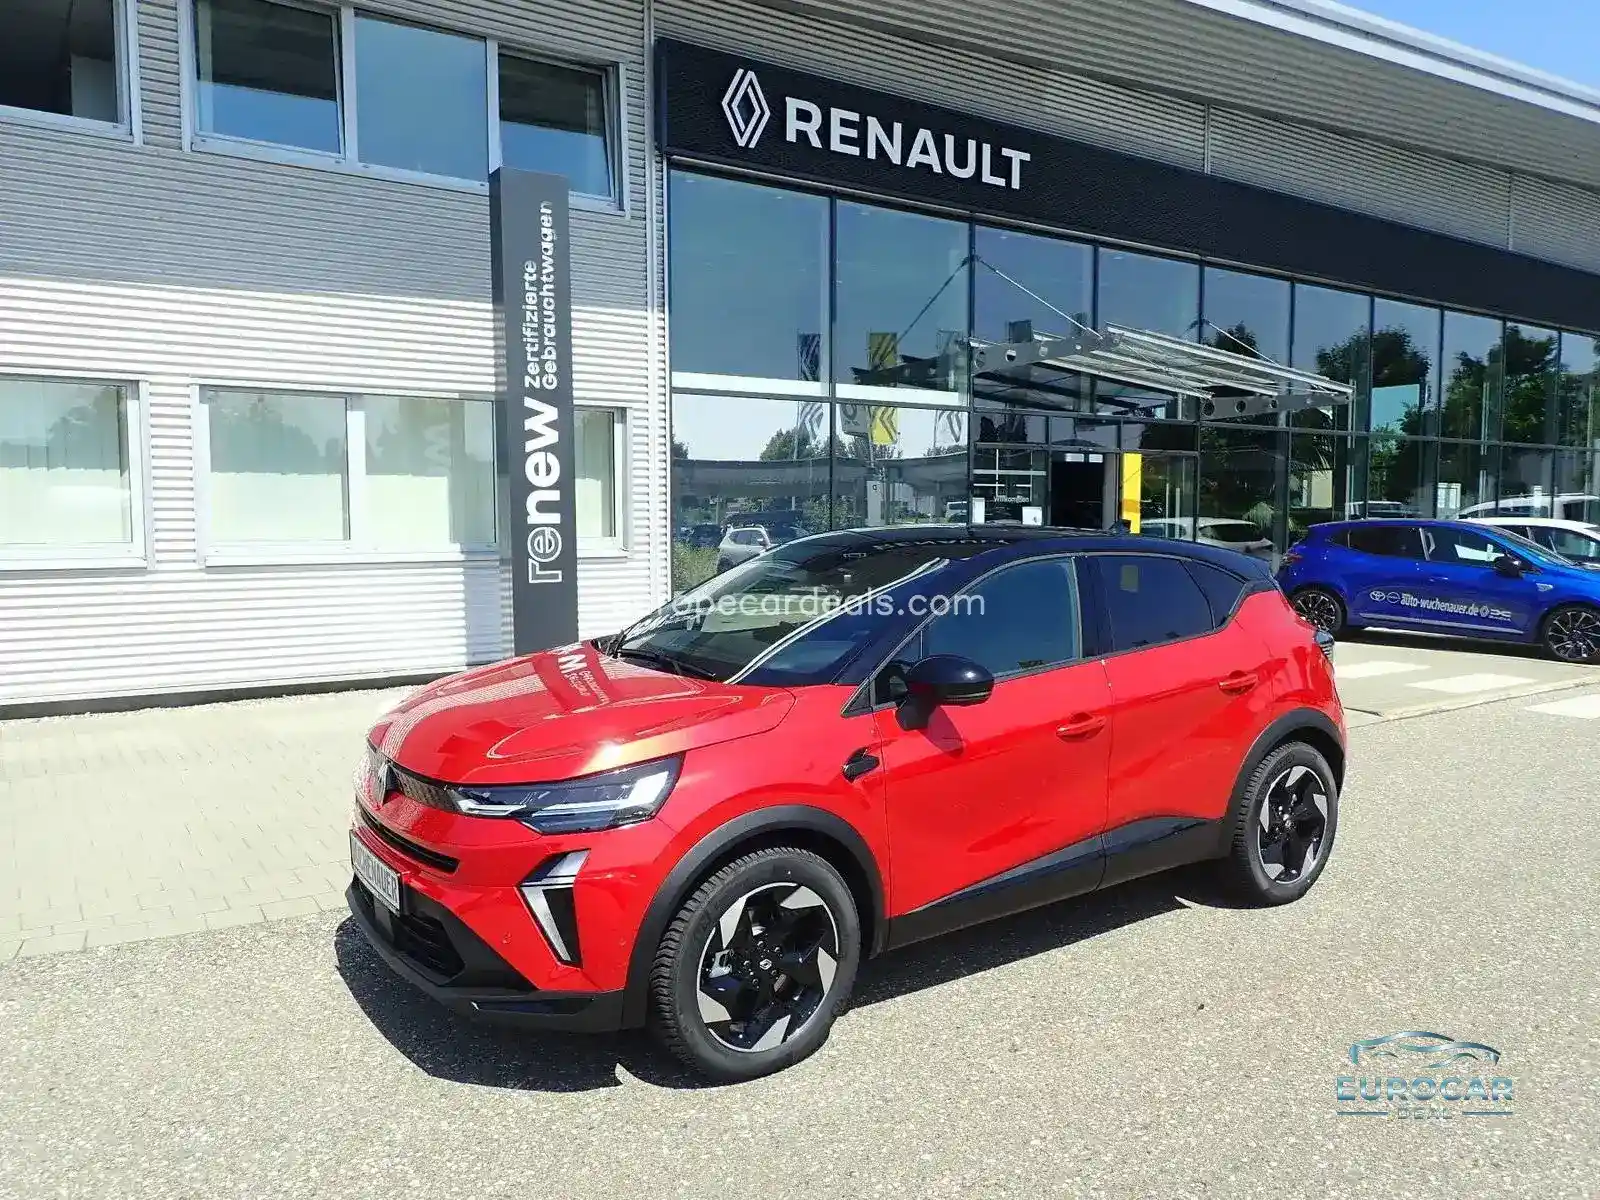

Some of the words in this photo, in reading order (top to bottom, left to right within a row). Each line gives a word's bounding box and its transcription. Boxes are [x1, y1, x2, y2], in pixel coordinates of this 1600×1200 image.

[785, 96, 1031, 190] RENAULT
[522, 260, 541, 389] Zertifizierte
[539, 200, 558, 390] Gebrauchtwagen
[523, 396, 563, 584] renew
[1400, 593, 1479, 617] auto-wuchenauer.de
